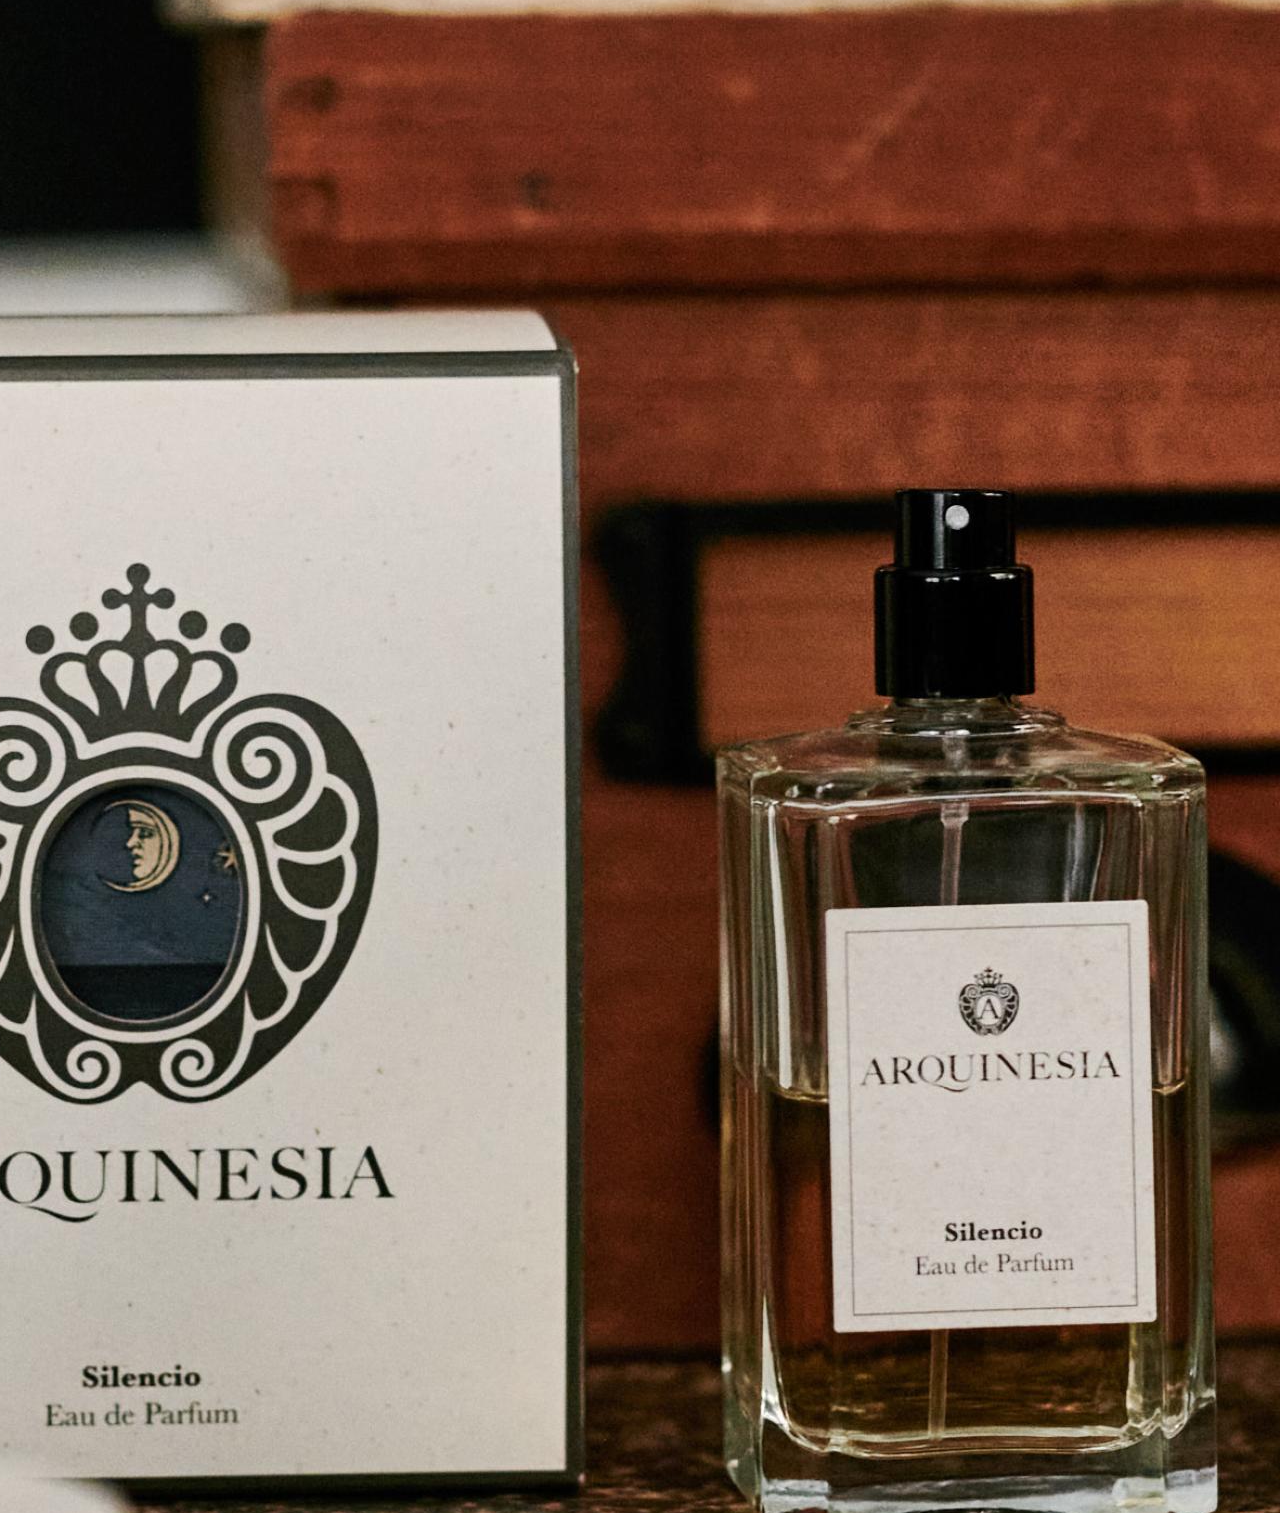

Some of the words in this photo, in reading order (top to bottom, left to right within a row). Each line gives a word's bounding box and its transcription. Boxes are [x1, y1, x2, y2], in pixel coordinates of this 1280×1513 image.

[976, 998, 1002, 1019] A
[861, 1051, 1121, 1093] ARQUINESIA
[944, 1220, 1044, 1242] Silencio
[915, 1256, 958, 1276] Eau
[963, 1253, 990, 1275] de
[997, 1252, 1076, 1273] Parfum
[82, 1364, 203, 1389] Silencio
[45, 1403, 97, 1428] Eau
[103, 1402, 136, 1427] de
[144, 1401, 240, 1426] Parfum
